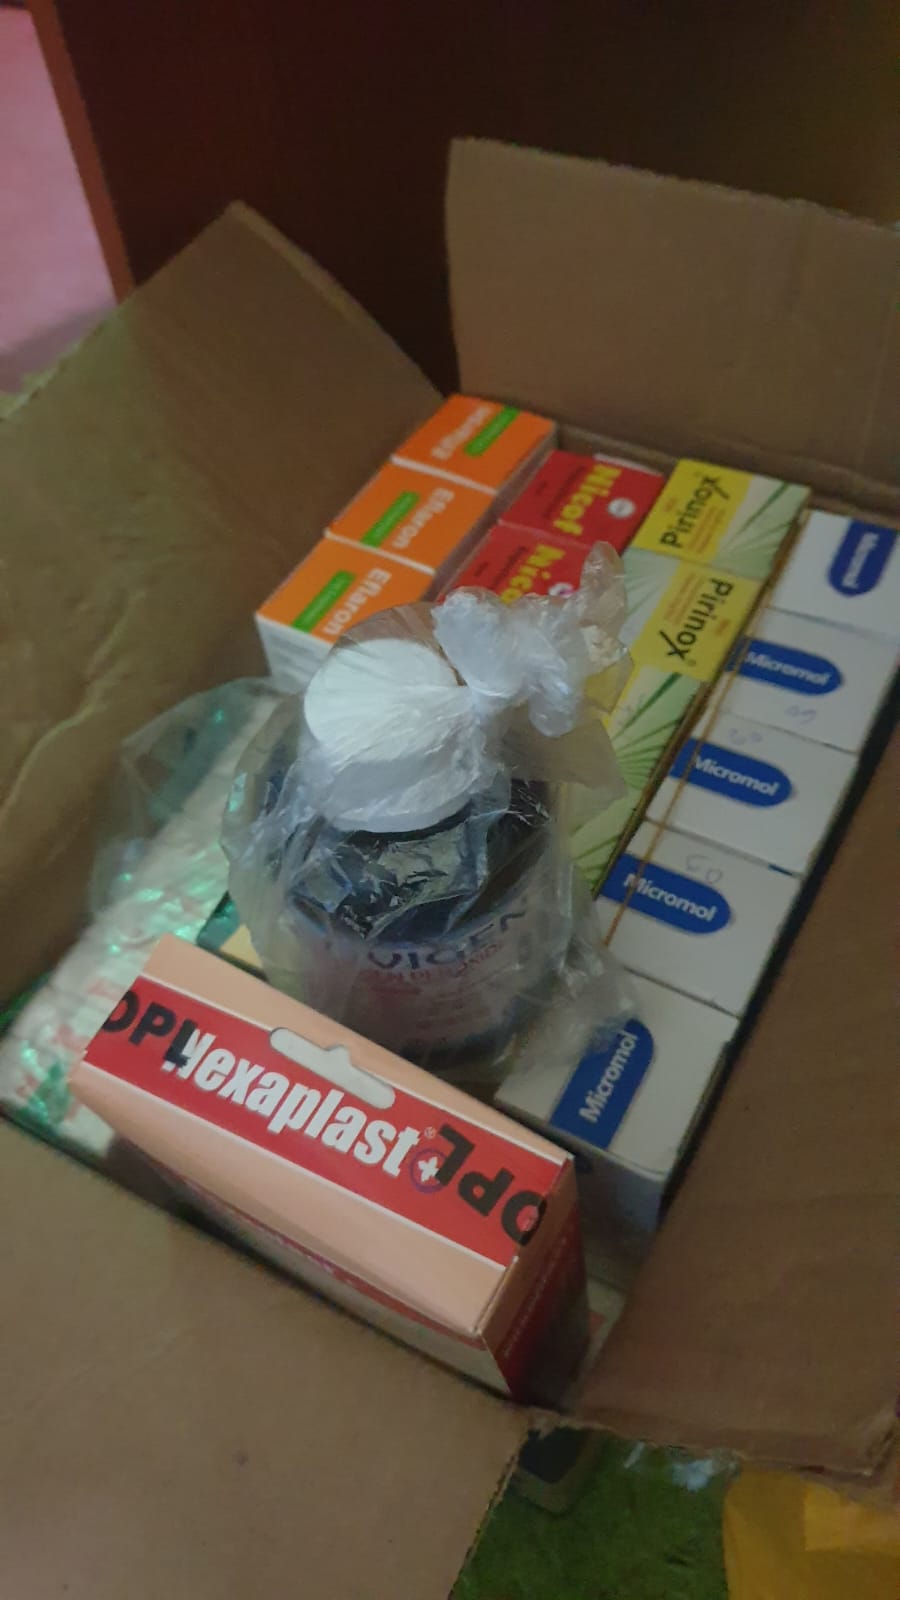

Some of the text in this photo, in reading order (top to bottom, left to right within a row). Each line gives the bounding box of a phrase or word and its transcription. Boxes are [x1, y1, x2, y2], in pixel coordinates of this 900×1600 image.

[660, 474, 729, 549] Pirinox
[658, 578, 734, 662] Pirinox
[744, 650, 832, 687] Micromol
[691, 755, 781, 798] Micromol
[622, 870, 719, 924] Micromol
[578, 1031, 639, 1124] Micromol
[434, 1123, 548, 1248] OPL
